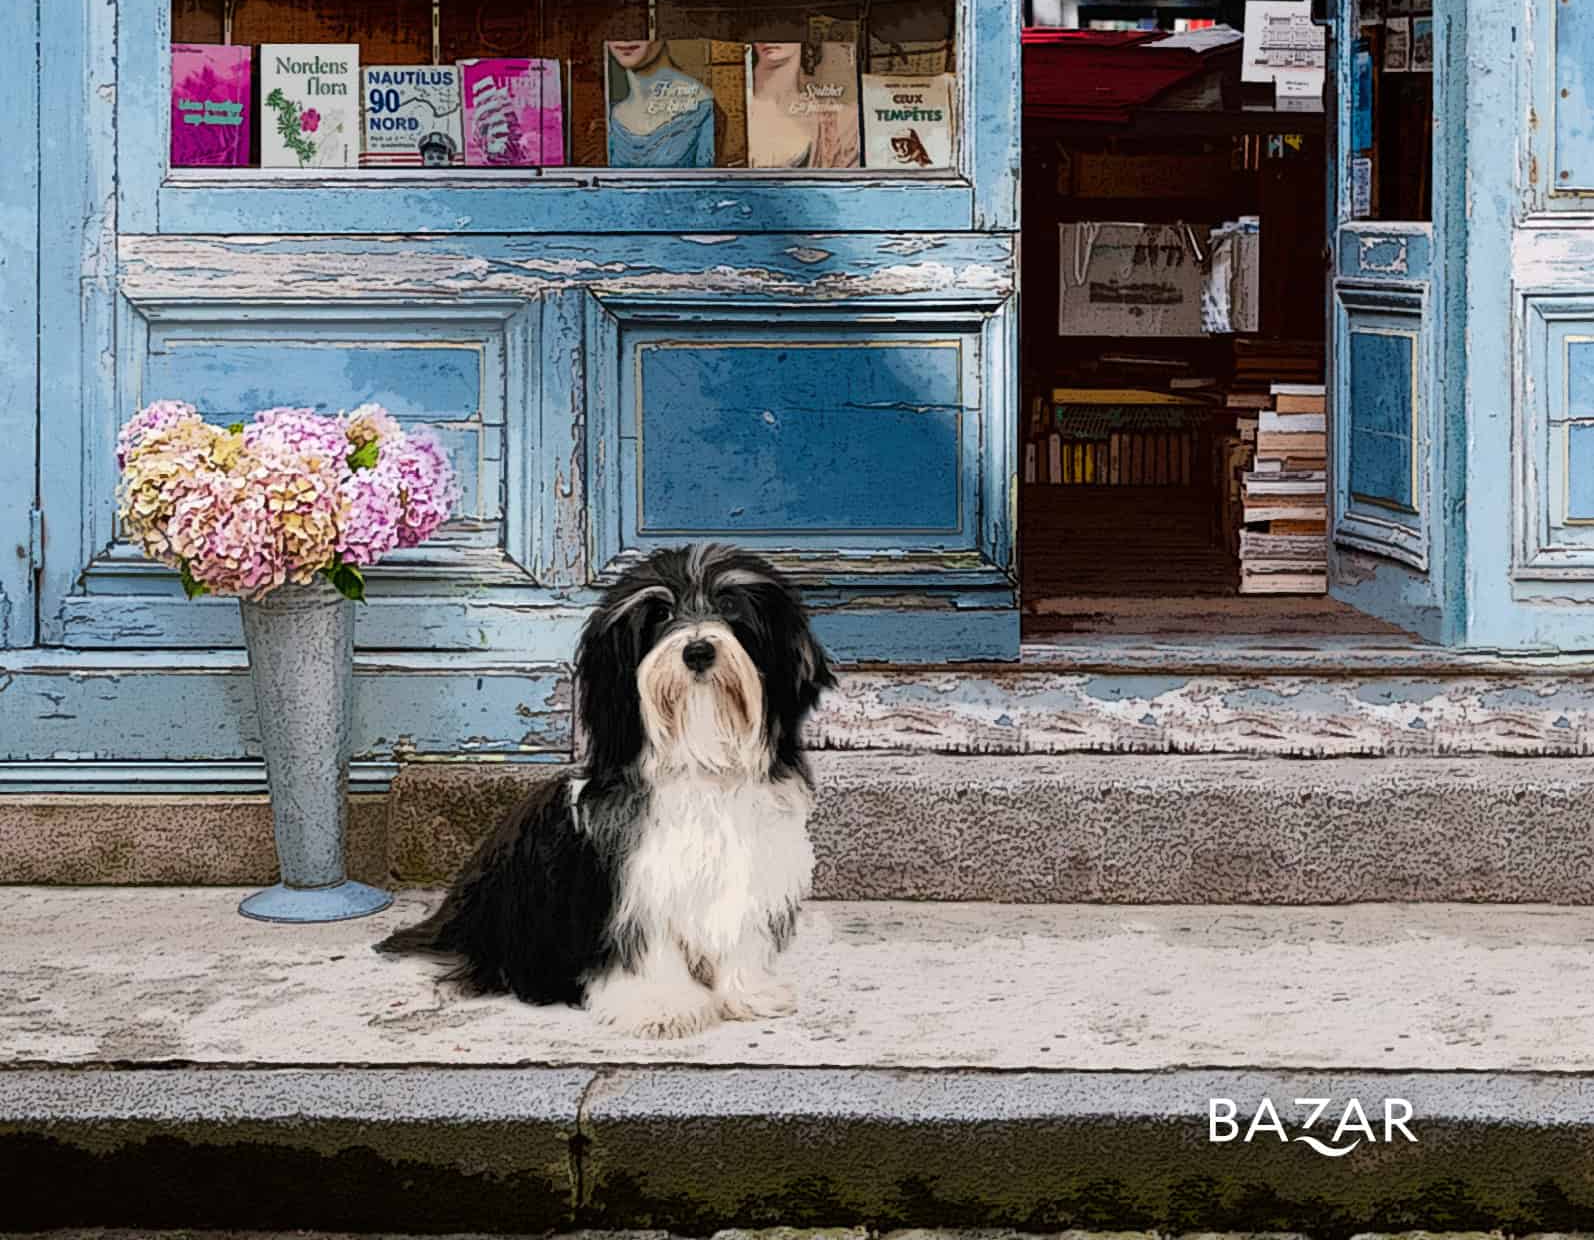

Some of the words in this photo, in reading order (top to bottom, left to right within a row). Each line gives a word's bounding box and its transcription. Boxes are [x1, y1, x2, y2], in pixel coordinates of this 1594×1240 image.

[276, 55, 348, 75] Nordens
[307, 76, 348, 96] flora
[368, 71, 454, 86] NAUTILUS
[369, 88, 400, 114] 90
[892, 93, 923, 104] CEUX
[874, 106, 943, 122] TEMPÊTES
[369, 117, 419, 131] NORD
